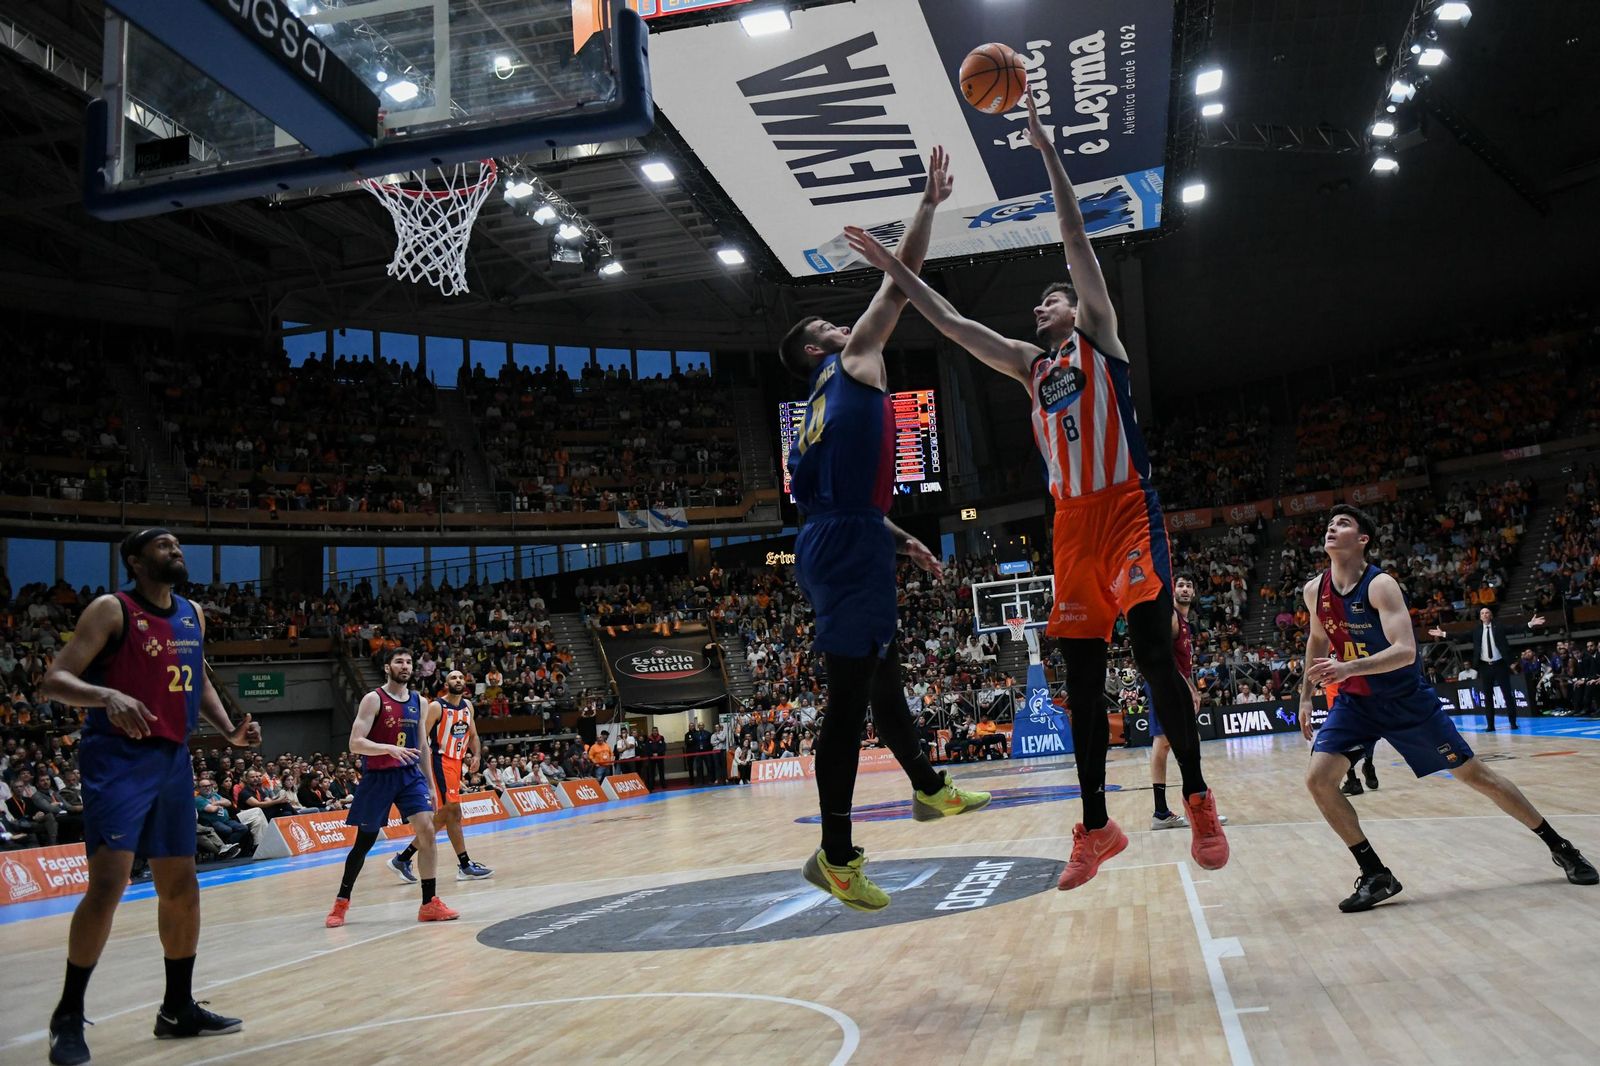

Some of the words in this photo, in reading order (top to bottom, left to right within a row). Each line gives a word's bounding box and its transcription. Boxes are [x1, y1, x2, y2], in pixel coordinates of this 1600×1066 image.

[1120, 24, 1136, 56] 1962
[1062, 30, 1118, 137] Leyma
[1120, 60, 1135, 91] dende
[736, 31, 928, 206] LEYMA
[1122, 94, 1135, 135] Auténtica
[1064, 139, 1110, 155] é
[1041, 372, 1075, 396] Estrella
[1045, 383, 1077, 405] Galicia
[1062, 414, 1079, 442] 8
[631, 655, 694, 665] Estrella
[1343, 642, 1370, 661] 45
[167, 665, 193, 692] 22
[635, 663, 694, 673] Galicia
[1222, 710, 1273, 735] LEYMA
[396, 732, 407, 747] 8
[1021, 733, 1065, 754] LEYMA
[758, 760, 804, 780] LEYMA
[513, 790, 549, 812] LEYMA
[316, 831, 345, 844] lenda
